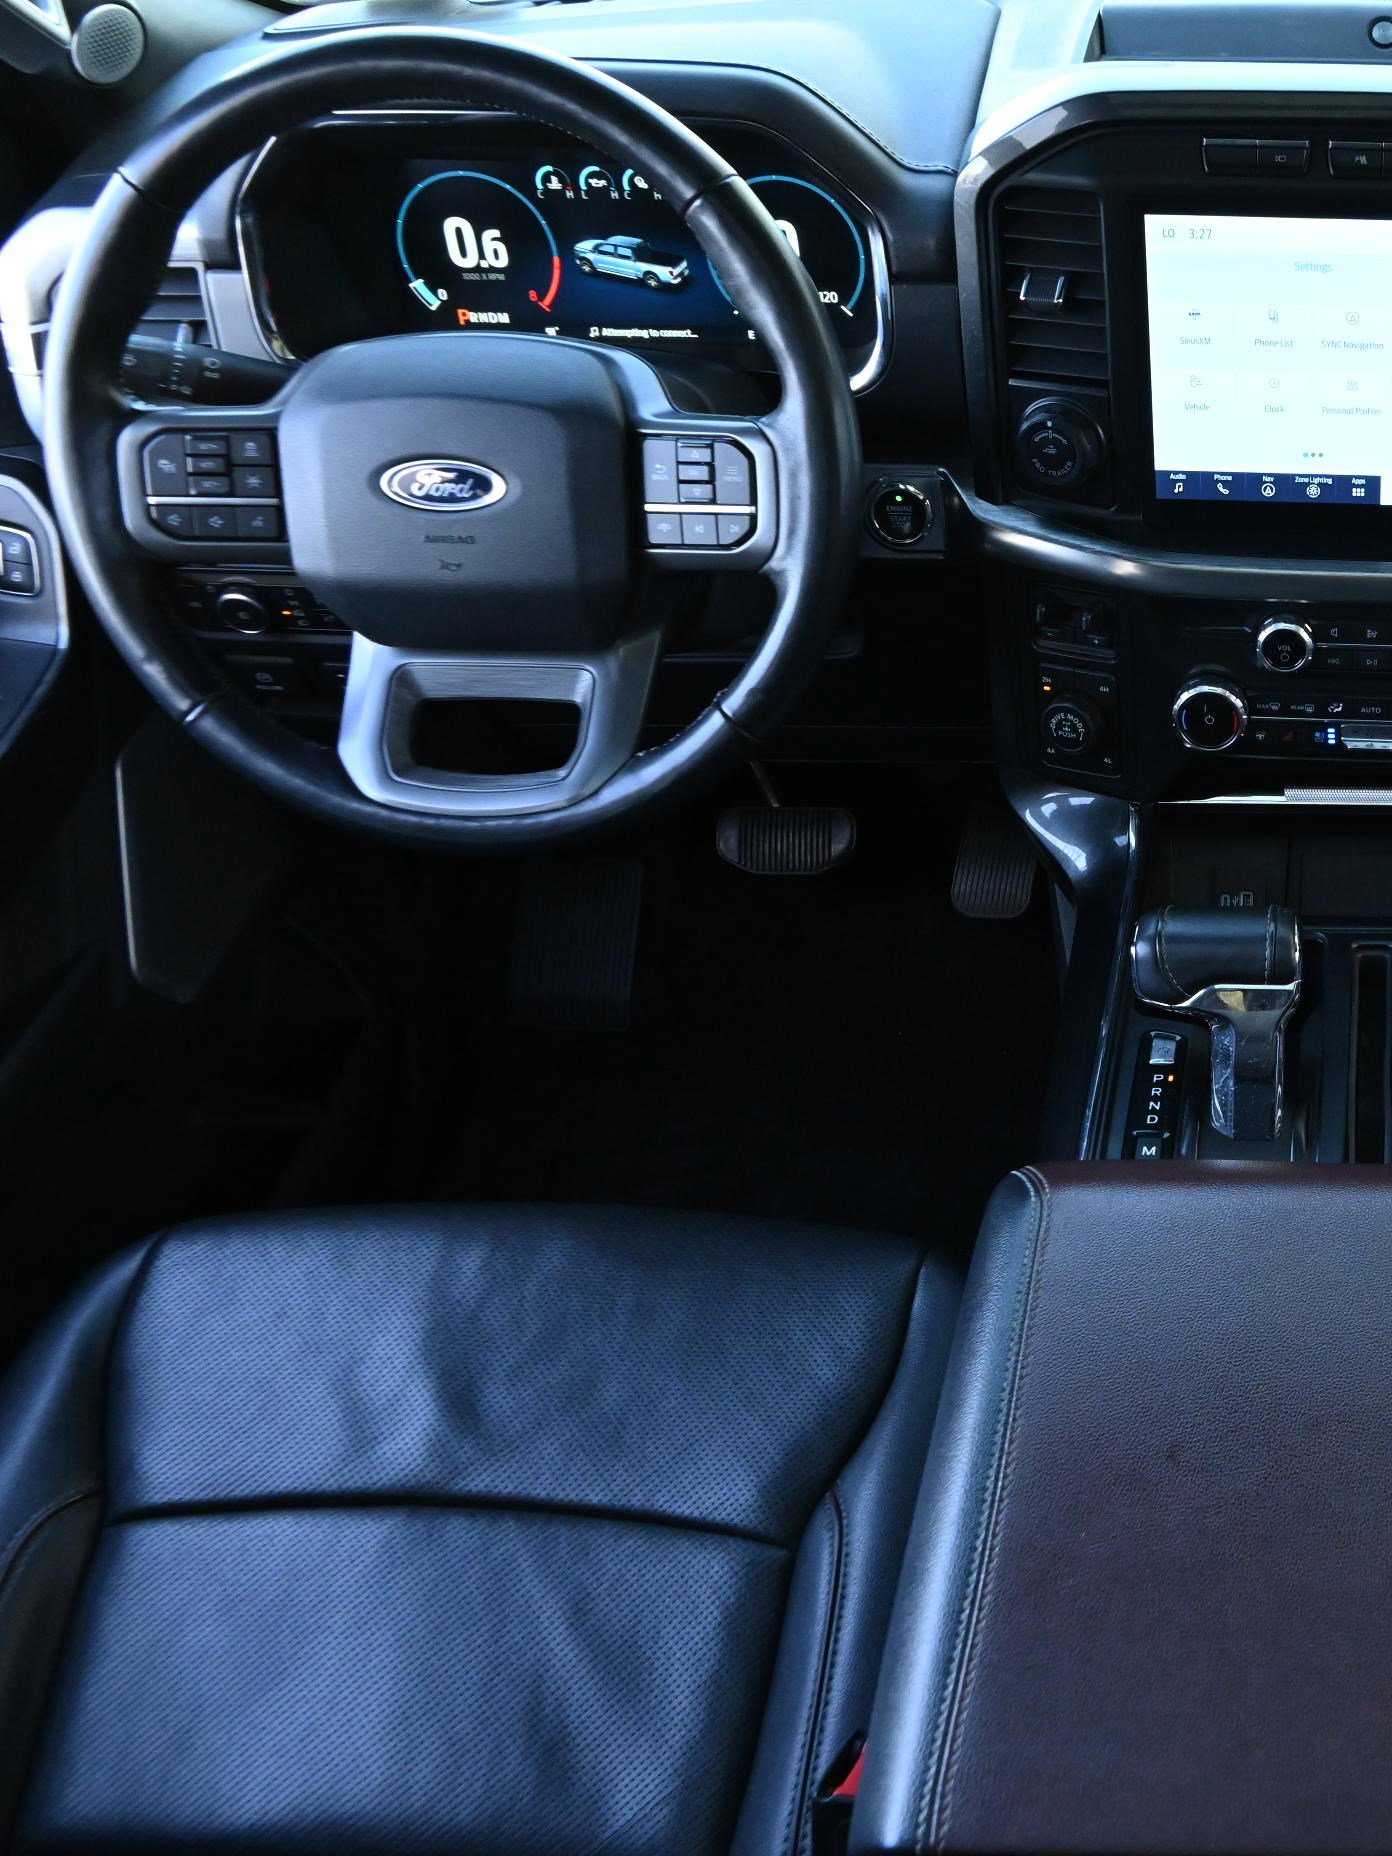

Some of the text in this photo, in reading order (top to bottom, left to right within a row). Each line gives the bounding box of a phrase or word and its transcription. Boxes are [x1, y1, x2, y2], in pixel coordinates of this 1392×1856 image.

[536, 190, 545, 199] C
[566, 190, 575, 199] H
[581, 190, 589, 199] L
[610, 190, 620, 199] H
[623, 190, 632, 199] C
[1188, 228, 1212, 240] 3:27
[443, 216, 509, 268] 0.6
[1294, 261, 1333, 274] Settings
[437, 288, 448, 300] 0
[601, 327, 650, 338] Attempting
[747, 329, 756, 339] E
[1254, 338, 1294, 349] Phone List
[1321, 340, 1384, 351] SYNC Navigation
[1184, 402, 1211, 412] Vehicle
[1264, 404, 1284, 413] Clock
[1321, 406, 1354, 416] Personal
[1031, 458, 1074, 477] PRO TRAILER
[1169, 472, 1187, 480] Audio
[1213, 473, 1233, 481] Phone
[1294, 475, 1333, 485] Zone Lighting
[1351, 477, 1366, 485] Apps
[410, 469, 474, 498] Ford
[1277, 643, 1293, 653] VOL
[1360, 704, 1382, 715] AUTO
[1050, 712, 1085, 734] DRIVE MODE
[1058, 730, 1077, 739] PUSH
[1152, 1073, 1164, 1083] P
[1151, 1087, 1163, 1097] R
[1148, 1101, 1161, 1111] N
[1146, 1114, 1159, 1125] D
[1141, 1146, 1156, 1156] M
